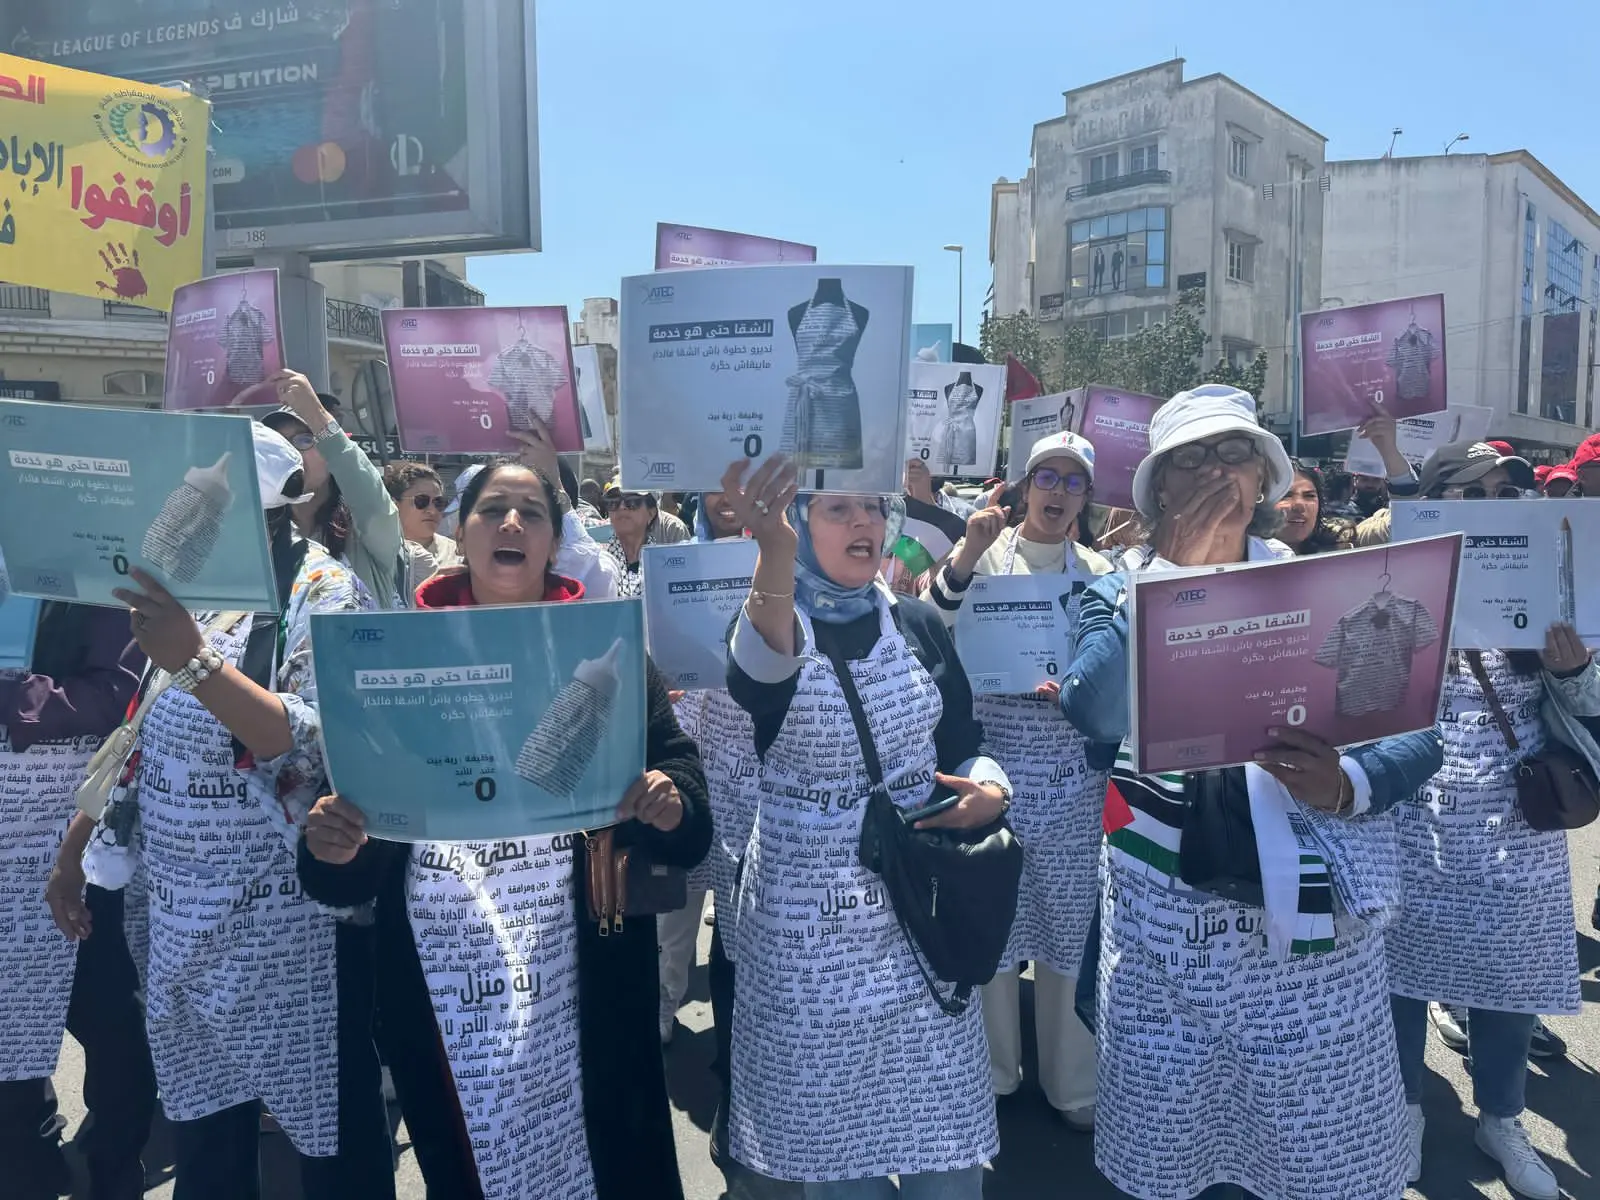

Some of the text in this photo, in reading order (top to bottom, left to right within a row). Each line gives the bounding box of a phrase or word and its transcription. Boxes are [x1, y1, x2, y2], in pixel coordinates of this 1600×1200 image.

[224, 12, 242, 30] ف
[252, 2, 298, 31] شارك
[147, 18, 219, 44] LEGENDS
[54, 34, 115, 56] LEAGUE
[120, 31, 140, 48] OF
[206, 64, 318, 90] PETITION
[212, 167, 232, 178] COM
[71, 164, 191, 248] أوقفوا
[246, 230, 266, 242] 188
[650, 286, 674, 297] ATEC
[653, 320, 771, 340] الشقا حتى هو خدمة
[677, 345, 700, 357] الشقا
[703, 345, 720, 357] باش
[723, 345, 746, 355] خطوة
[1316, 341, 1334, 350] خدمة
[1374, 390, 1384, 404] 0
[480, 414, 492, 430] 0
[744, 433, 762, 458] 0
[920, 448, 930, 460] 0
[14, 455, 128, 474] الشقا حتى هو خدمة
[650, 462, 675, 474] ATEC
[1418, 510, 1440, 519] ATEC
[1476, 536, 1526, 548] الشقا حتى
[1474, 552, 1488, 560] باش
[113, 554, 128, 576] 0
[672, 581, 728, 592] حتى هو خدمة
[1176, 588, 1206, 602] ATEC
[976, 604, 994, 612] خدمة
[1029, 602, 1051, 610] الشقا
[1168, 612, 1305, 642] الشقا حتى هو خدمة
[1514, 612, 1528, 630] 0
[351, 628, 384, 642] ATEC
[1256, 636, 1282, 648] خطوة
[1170, 648, 1198, 661] فالدار
[1202, 644, 1230, 655] الشقا
[1232, 642, 1253, 653] باش
[1046, 662, 1058, 676] 0
[361, 667, 510, 688] الشقا حتى هو خدمة
[362, 696, 391, 708] فالدار
[395, 694, 425, 705] الشقا
[430, 694, 450, 706] باش
[456, 692, 484, 704] خطوة
[1287, 704, 1306, 726] 0
[731, 759, 755, 780] منزل
[1050, 764, 1076, 784] منزل
[7, 773, 32, 784] وظيفة
[188, 775, 249, 804] وظيفة
[475, 776, 496, 802] 0
[1438, 788, 1458, 812] ربة
[378, 812, 409, 826] ATEC
[1476, 816, 1498, 830] يوجد
[14, 854, 40, 868] يوجد
[538, 894, 565, 906] وظيفة
[820, 885, 886, 916] ربة منزل
[413, 908, 468, 921] الإدارة بطاقة
[420, 922, 494, 942] والمناخ الاجتماعي
[782, 925, 816, 944] لا يوجد
[1186, 914, 1228, 945] منزل
[1170, 950, 1179, 967] لا
[460, 967, 541, 1005] ربة منزل
[1276, 966, 1346, 993] المنصب غير محددة
[445, 1019, 454, 1036] لا
[810, 1019, 824, 1031] بها
[1273, 1026, 1309, 1044] الوضعية
